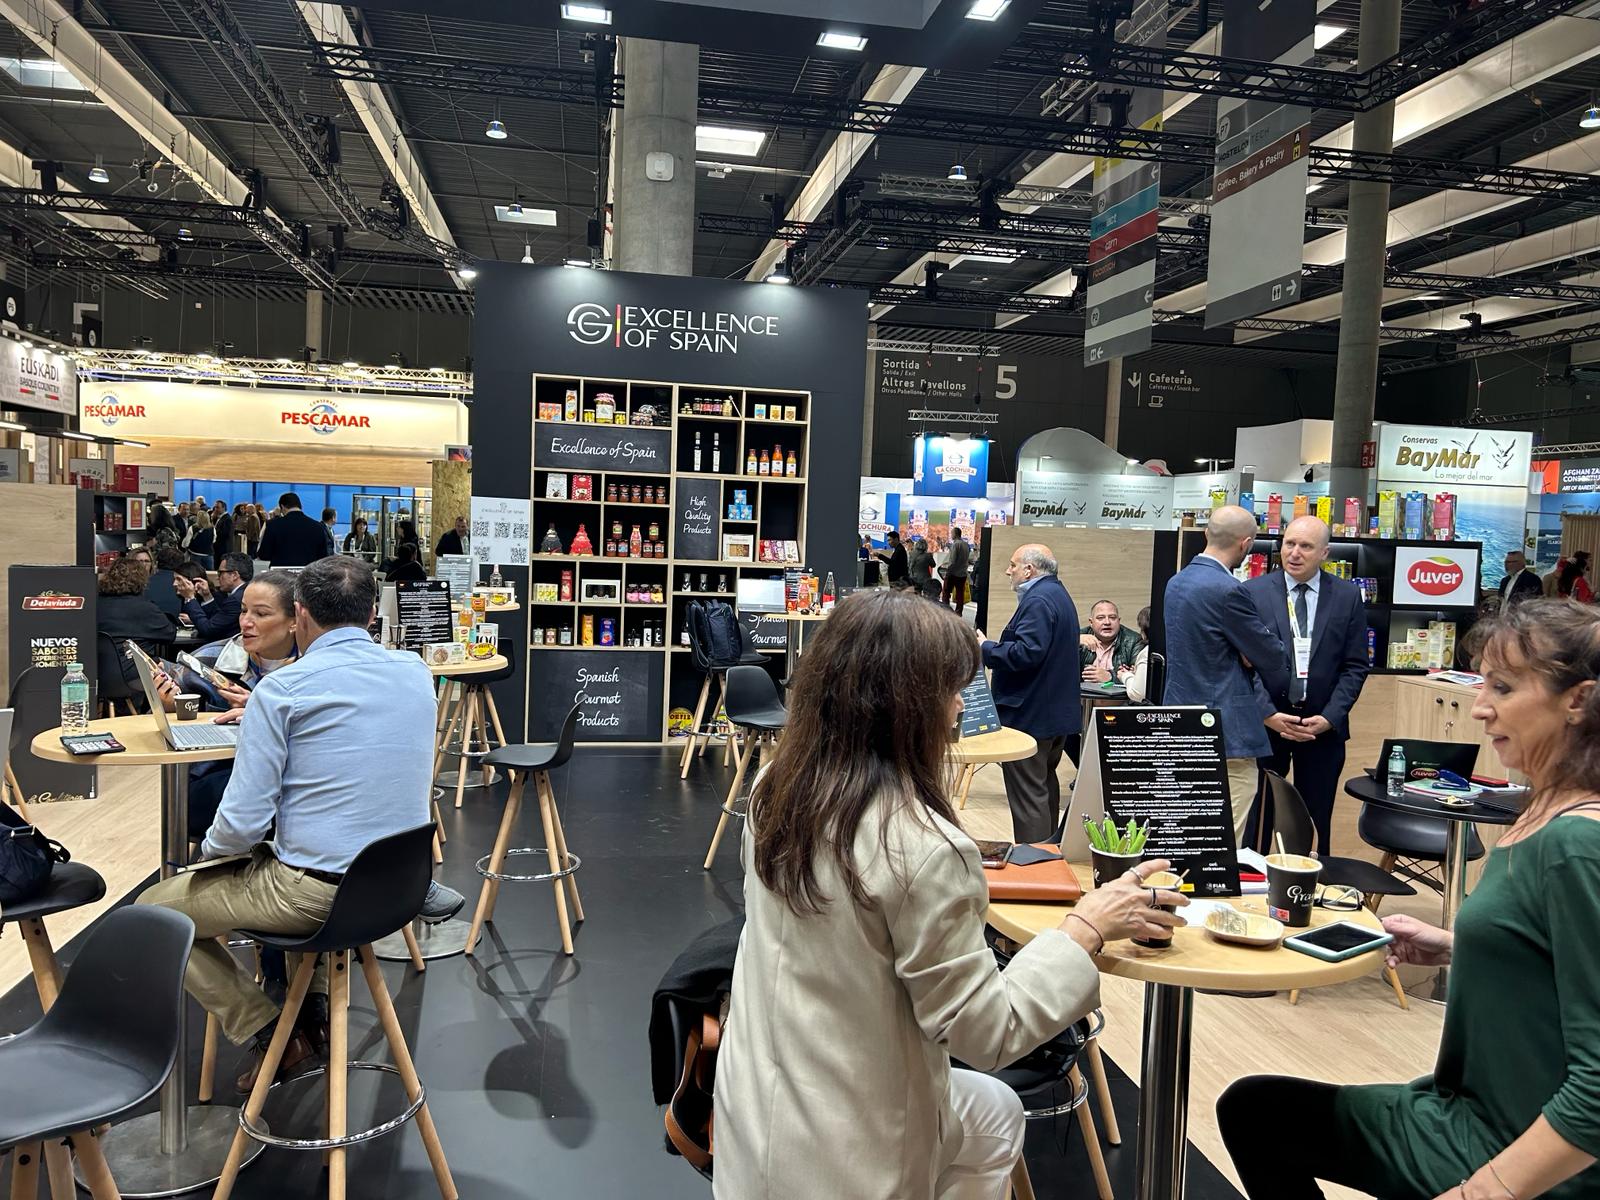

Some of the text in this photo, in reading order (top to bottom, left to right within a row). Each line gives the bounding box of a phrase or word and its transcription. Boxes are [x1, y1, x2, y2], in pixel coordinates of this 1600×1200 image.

[1294, 132, 1300, 143] A
[1217, 149, 1285, 192] Coffee, Bakery & Pastry
[624, 306, 779, 336] EXCELLENCE
[624, 328, 738, 354] OF SPAIN
[20, 356, 60, 383] EUSKADI
[883, 357, 920, 370] Sortida
[883, 368, 898, 377] Salida
[1149, 373, 1192, 385] Cafeteria
[882, 376, 915, 388] Altres
[995, 364, 1018, 400] 5
[1149, 383, 1173, 391] Cafeteria
[881, 386, 896, 395] Otros
[932, 389, 947, 397] Other
[84, 405, 147, 418] PESCAMAR
[281, 411, 372, 428] PESCAMAR
[1402, 435, 1439, 447] Conservas
[551, 437, 657, 465] Excellence of Spain
[1395, 445, 1482, 472] BayMar
[1434, 469, 1494, 483] Lo mejor del mar
[1563, 468, 1591, 477] AFGHAN
[689, 495, 707, 511] High
[685, 510, 711, 525] Quality
[683, 523, 712, 534] Products
[1410, 568, 1460, 585] Juver
[30, 599, 78, 608] Delaviuda
[31, 637, 78, 648] NUEVOS
[32, 647, 78, 656] SABORES
[32, 655, 78, 663] EXPERIENCIAS
[576, 667, 620, 689] Spanish
[577, 710, 620, 726] Products
[1147, 712, 1182, 720] EXCELLENCE
